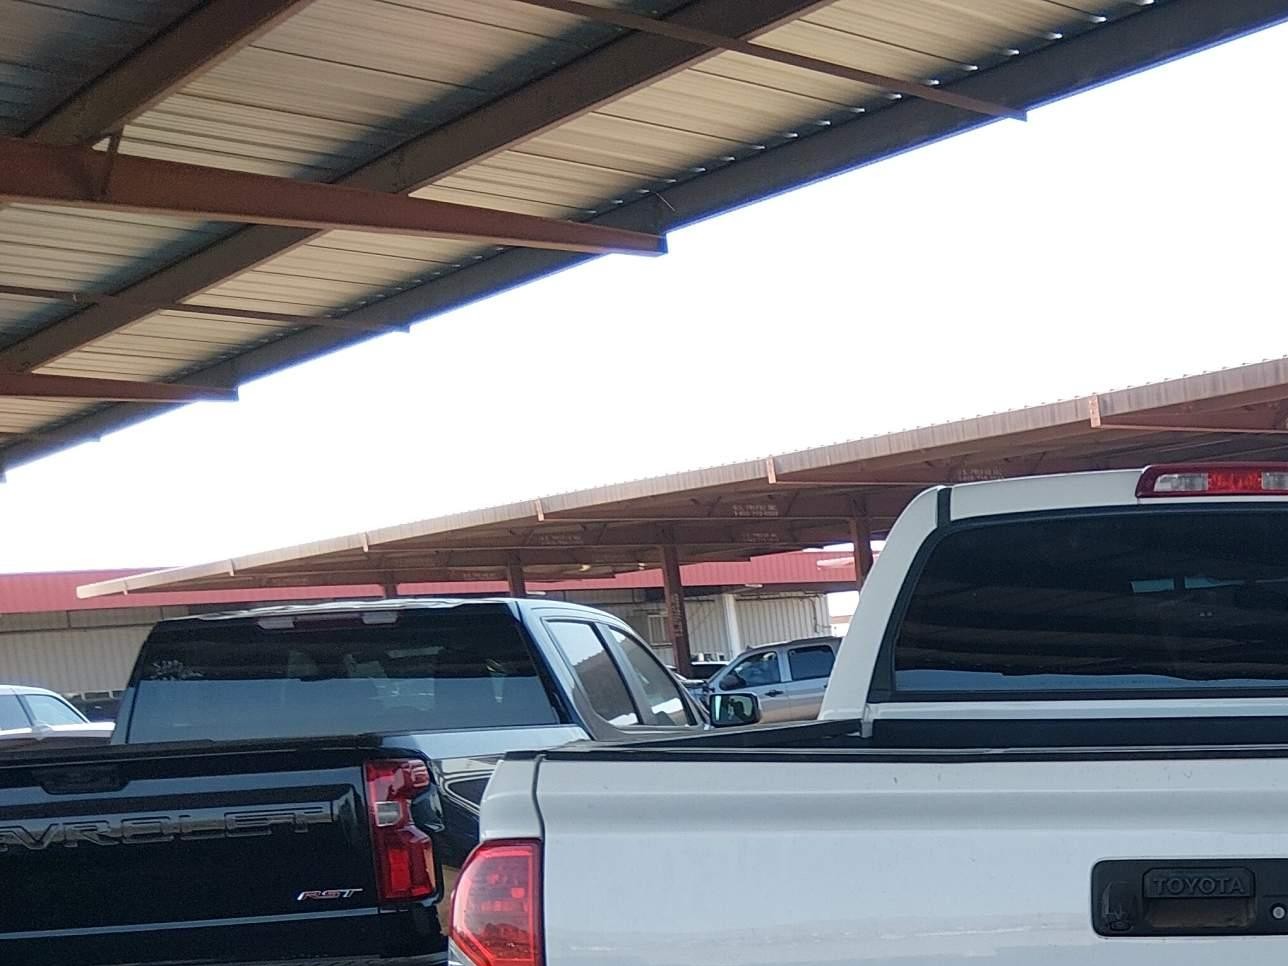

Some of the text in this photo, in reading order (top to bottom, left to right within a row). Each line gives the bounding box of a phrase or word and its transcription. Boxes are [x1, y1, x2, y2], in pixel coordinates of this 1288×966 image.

[0, 806, 325, 853] VROLET
[297, 888, 363, 901] RST
[1152, 876, 1246, 896] TOYOTA
